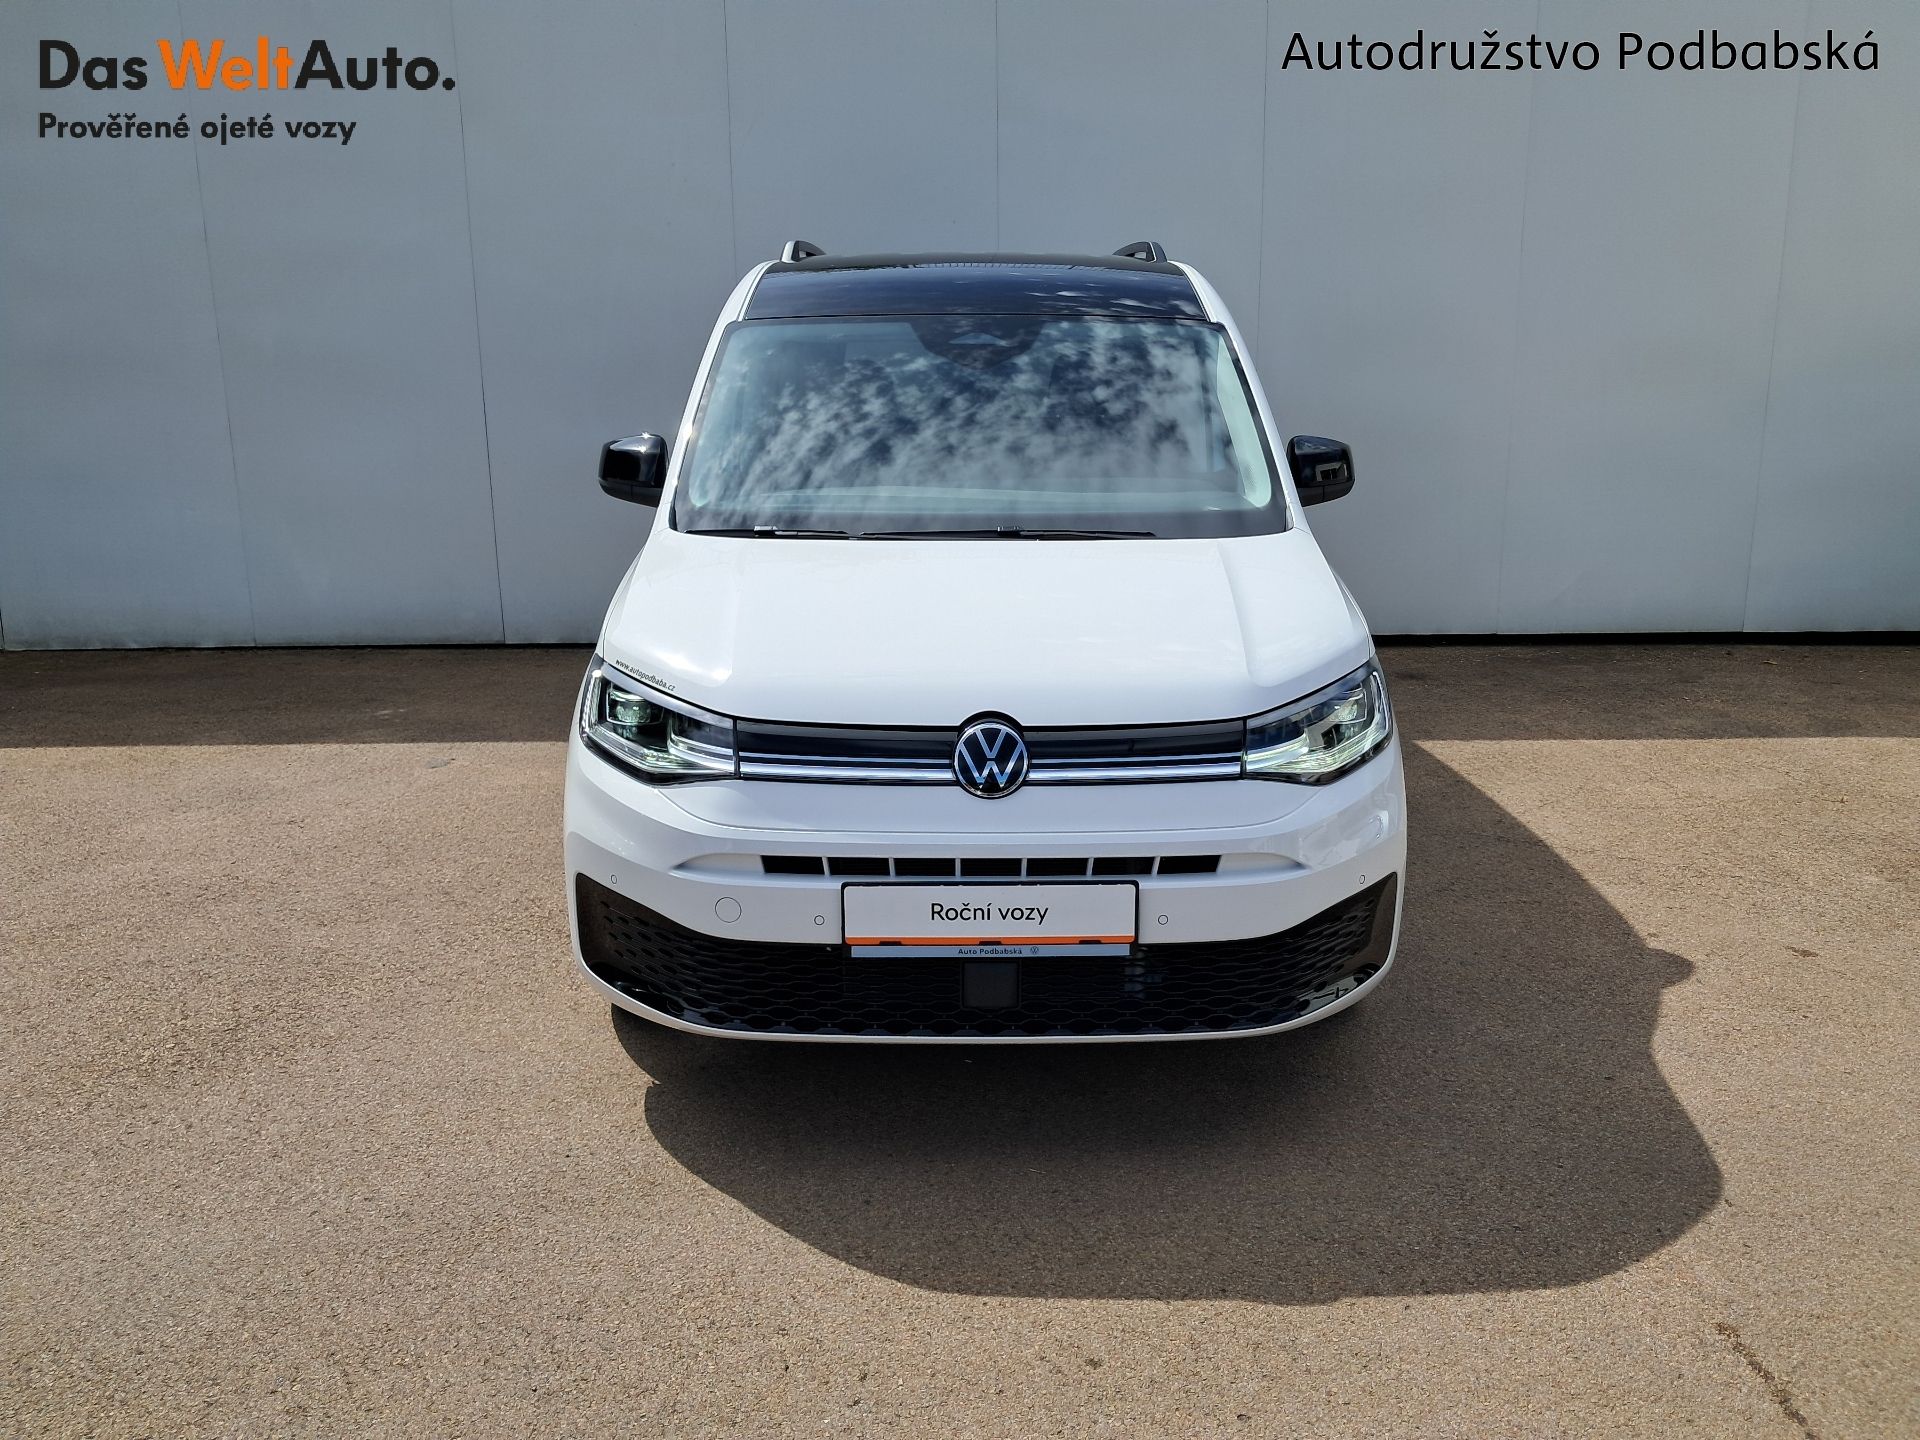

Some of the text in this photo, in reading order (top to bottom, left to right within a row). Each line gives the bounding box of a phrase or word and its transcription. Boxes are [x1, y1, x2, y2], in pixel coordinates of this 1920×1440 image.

[615, 659, 676, 691] www.autopodbaba.cz
[930, 902, 1049, 925] Roční vozy
[957, 946, 978, 956] Auto
[980, 945, 1022, 956] Podbabská
